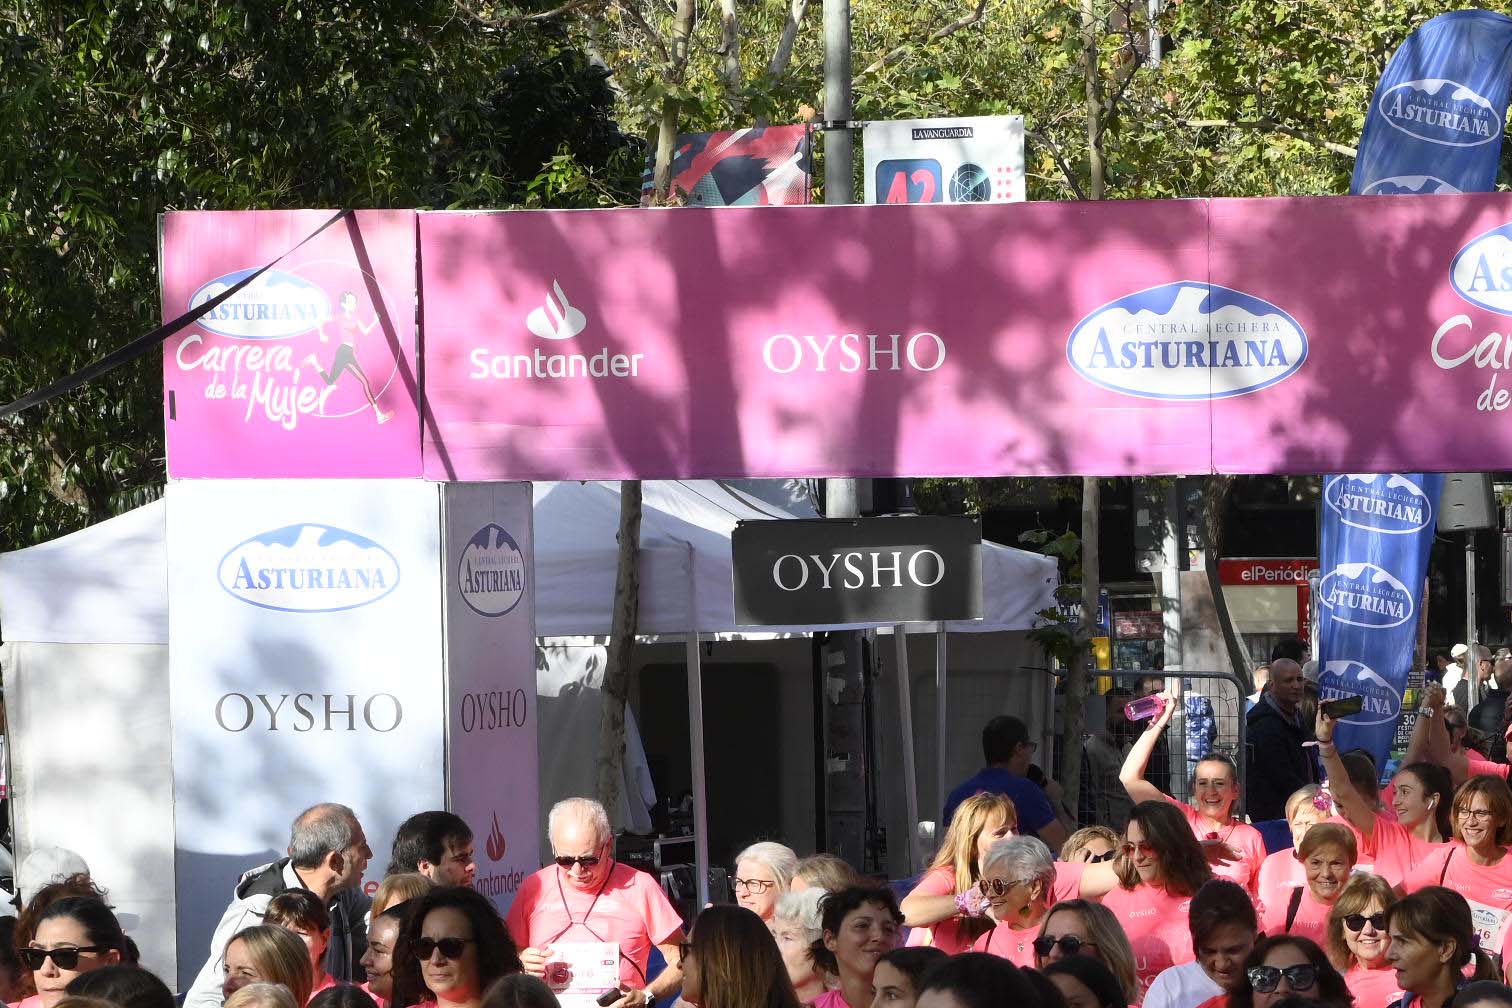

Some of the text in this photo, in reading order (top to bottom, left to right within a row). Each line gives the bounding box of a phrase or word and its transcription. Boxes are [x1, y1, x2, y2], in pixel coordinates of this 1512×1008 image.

[1388, 93, 1492, 138] ASTURIANA
[1206, 321, 1281, 333] LECHERA
[176, 335, 293, 371] Carrera
[470, 347, 644, 379] Santander
[763, 332, 946, 373] OYSHO
[1086, 326, 1289, 368] ASTURIANA
[205, 368, 338, 430] de la Mujer
[1477, 374, 1511, 411] de
[232, 557, 387, 590] ASTURIANA
[464, 558, 521, 594] ASTURIANA
[772, 549, 946, 591] OYSHO
[214, 693, 403, 732] OYSHO
[461, 689, 526, 733] OYSHO
[1404, 715, 1415, 725] 30
